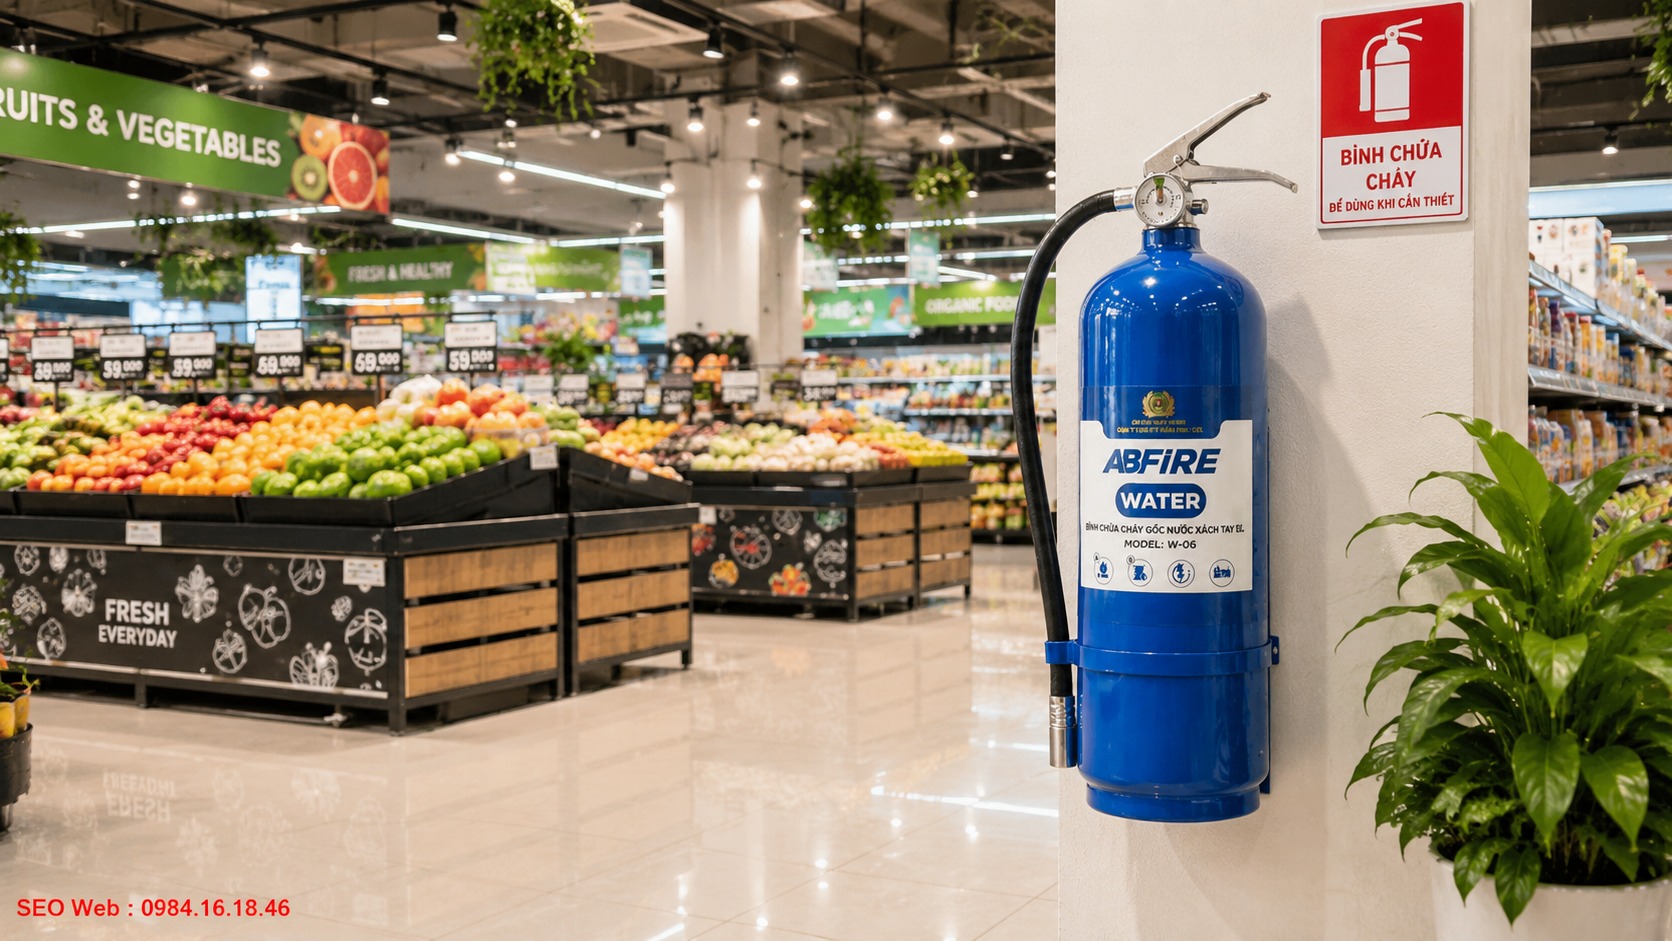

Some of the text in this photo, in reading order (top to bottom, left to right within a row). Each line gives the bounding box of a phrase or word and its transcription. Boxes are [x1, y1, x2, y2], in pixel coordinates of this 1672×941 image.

[86, 103, 109, 137] &
[116, 109, 282, 168] VEGETABLES
[1377, 198, 1395, 210] KHI
[399, 261, 455, 281] HEALTHY
[925, 297, 983, 315] ORGANIC
[1120, 492, 1201, 510] WATER
[1220, 525, 1234, 534] TAY
[1123, 539, 1197, 549] MODEL: W-06
[104, 598, 170, 626] FRESH
[98, 624, 178, 649] EVERYDAY
